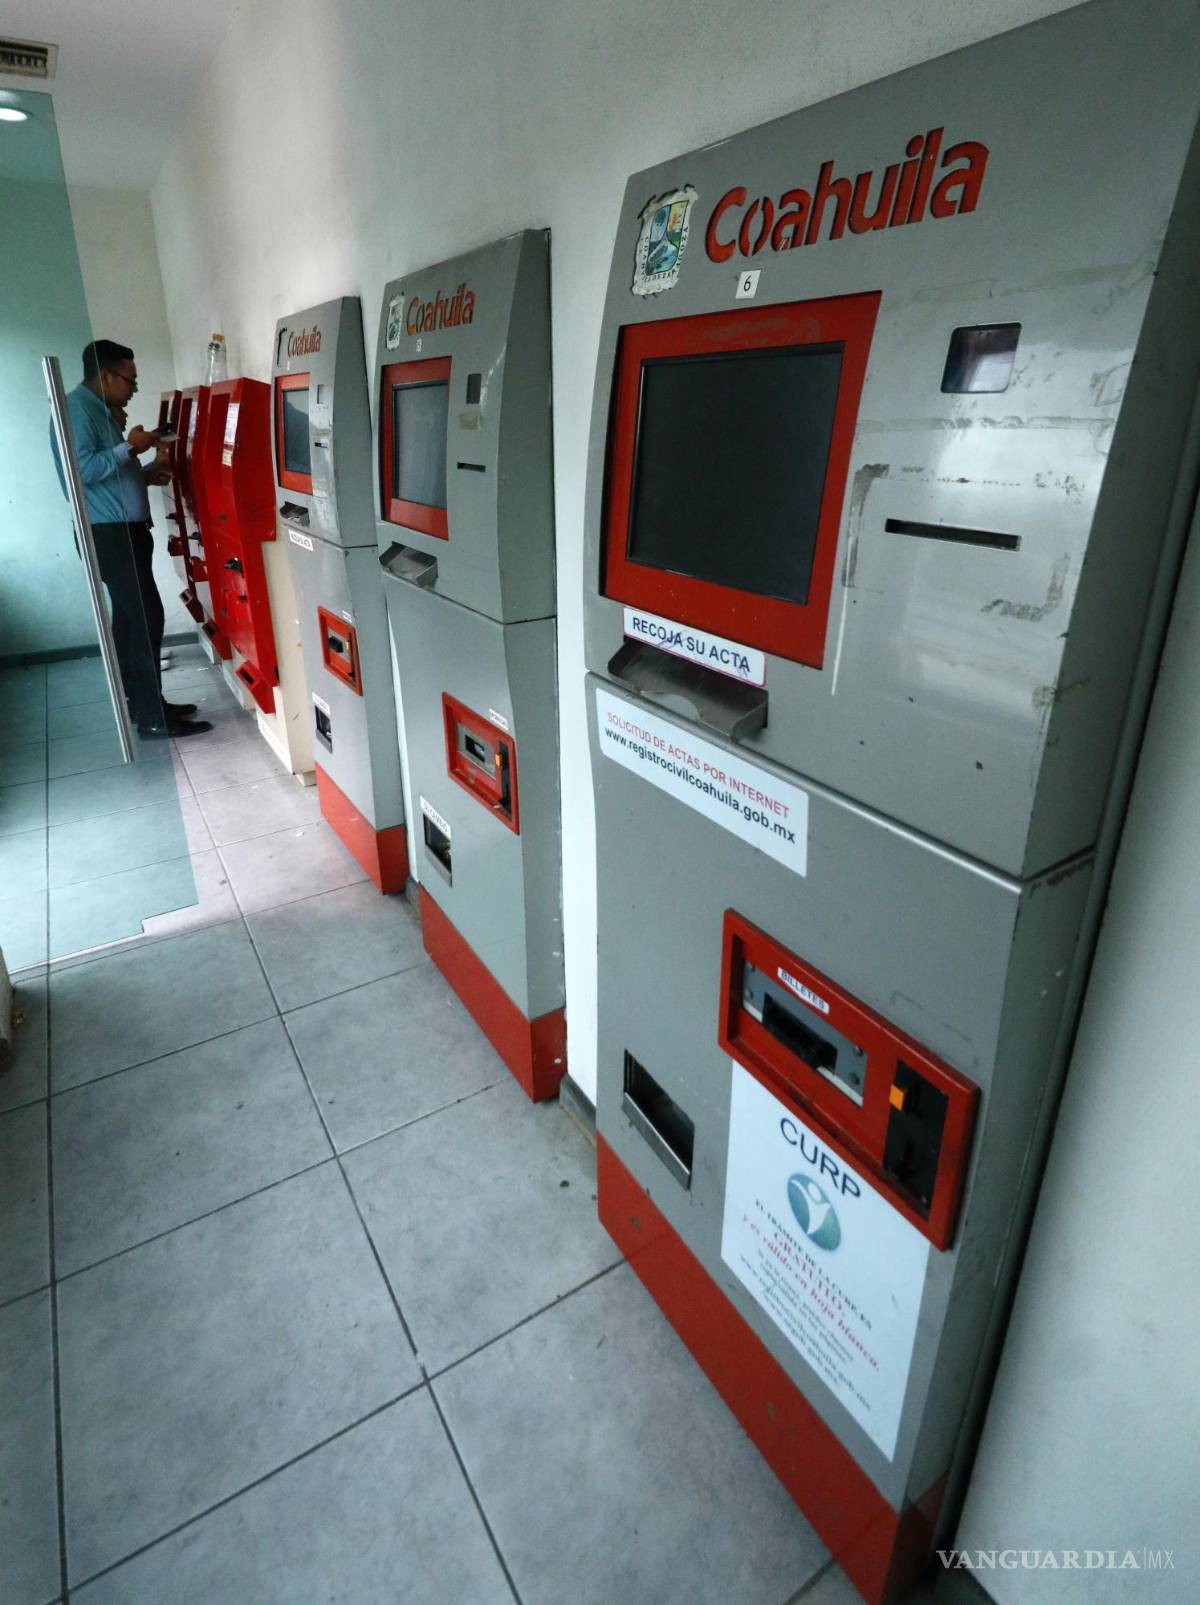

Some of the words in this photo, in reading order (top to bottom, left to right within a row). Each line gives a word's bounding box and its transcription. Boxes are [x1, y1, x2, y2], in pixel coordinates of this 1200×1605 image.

[705, 126, 990, 264] Coahuila
[406, 282, 477, 336] Coahuila
[743, 274, 752, 292] 6
[632, 617, 684, 648] RECOJA
[686, 636, 706, 656] SU
[709, 645, 751, 673] ACTA
[604, 727, 796, 844] www.registrocivilcoahuila.gob.mx
[607, 712, 652, 742] SOLICITUD
[653, 736, 666, 751] DE
[668, 745, 701, 770] ACTAS
[703, 763, 726, 785] POR
[729, 777, 790, 818] INTERNET
[781, 969, 826, 1009] BILLETES
[780, 1117, 862, 1198] CURP
